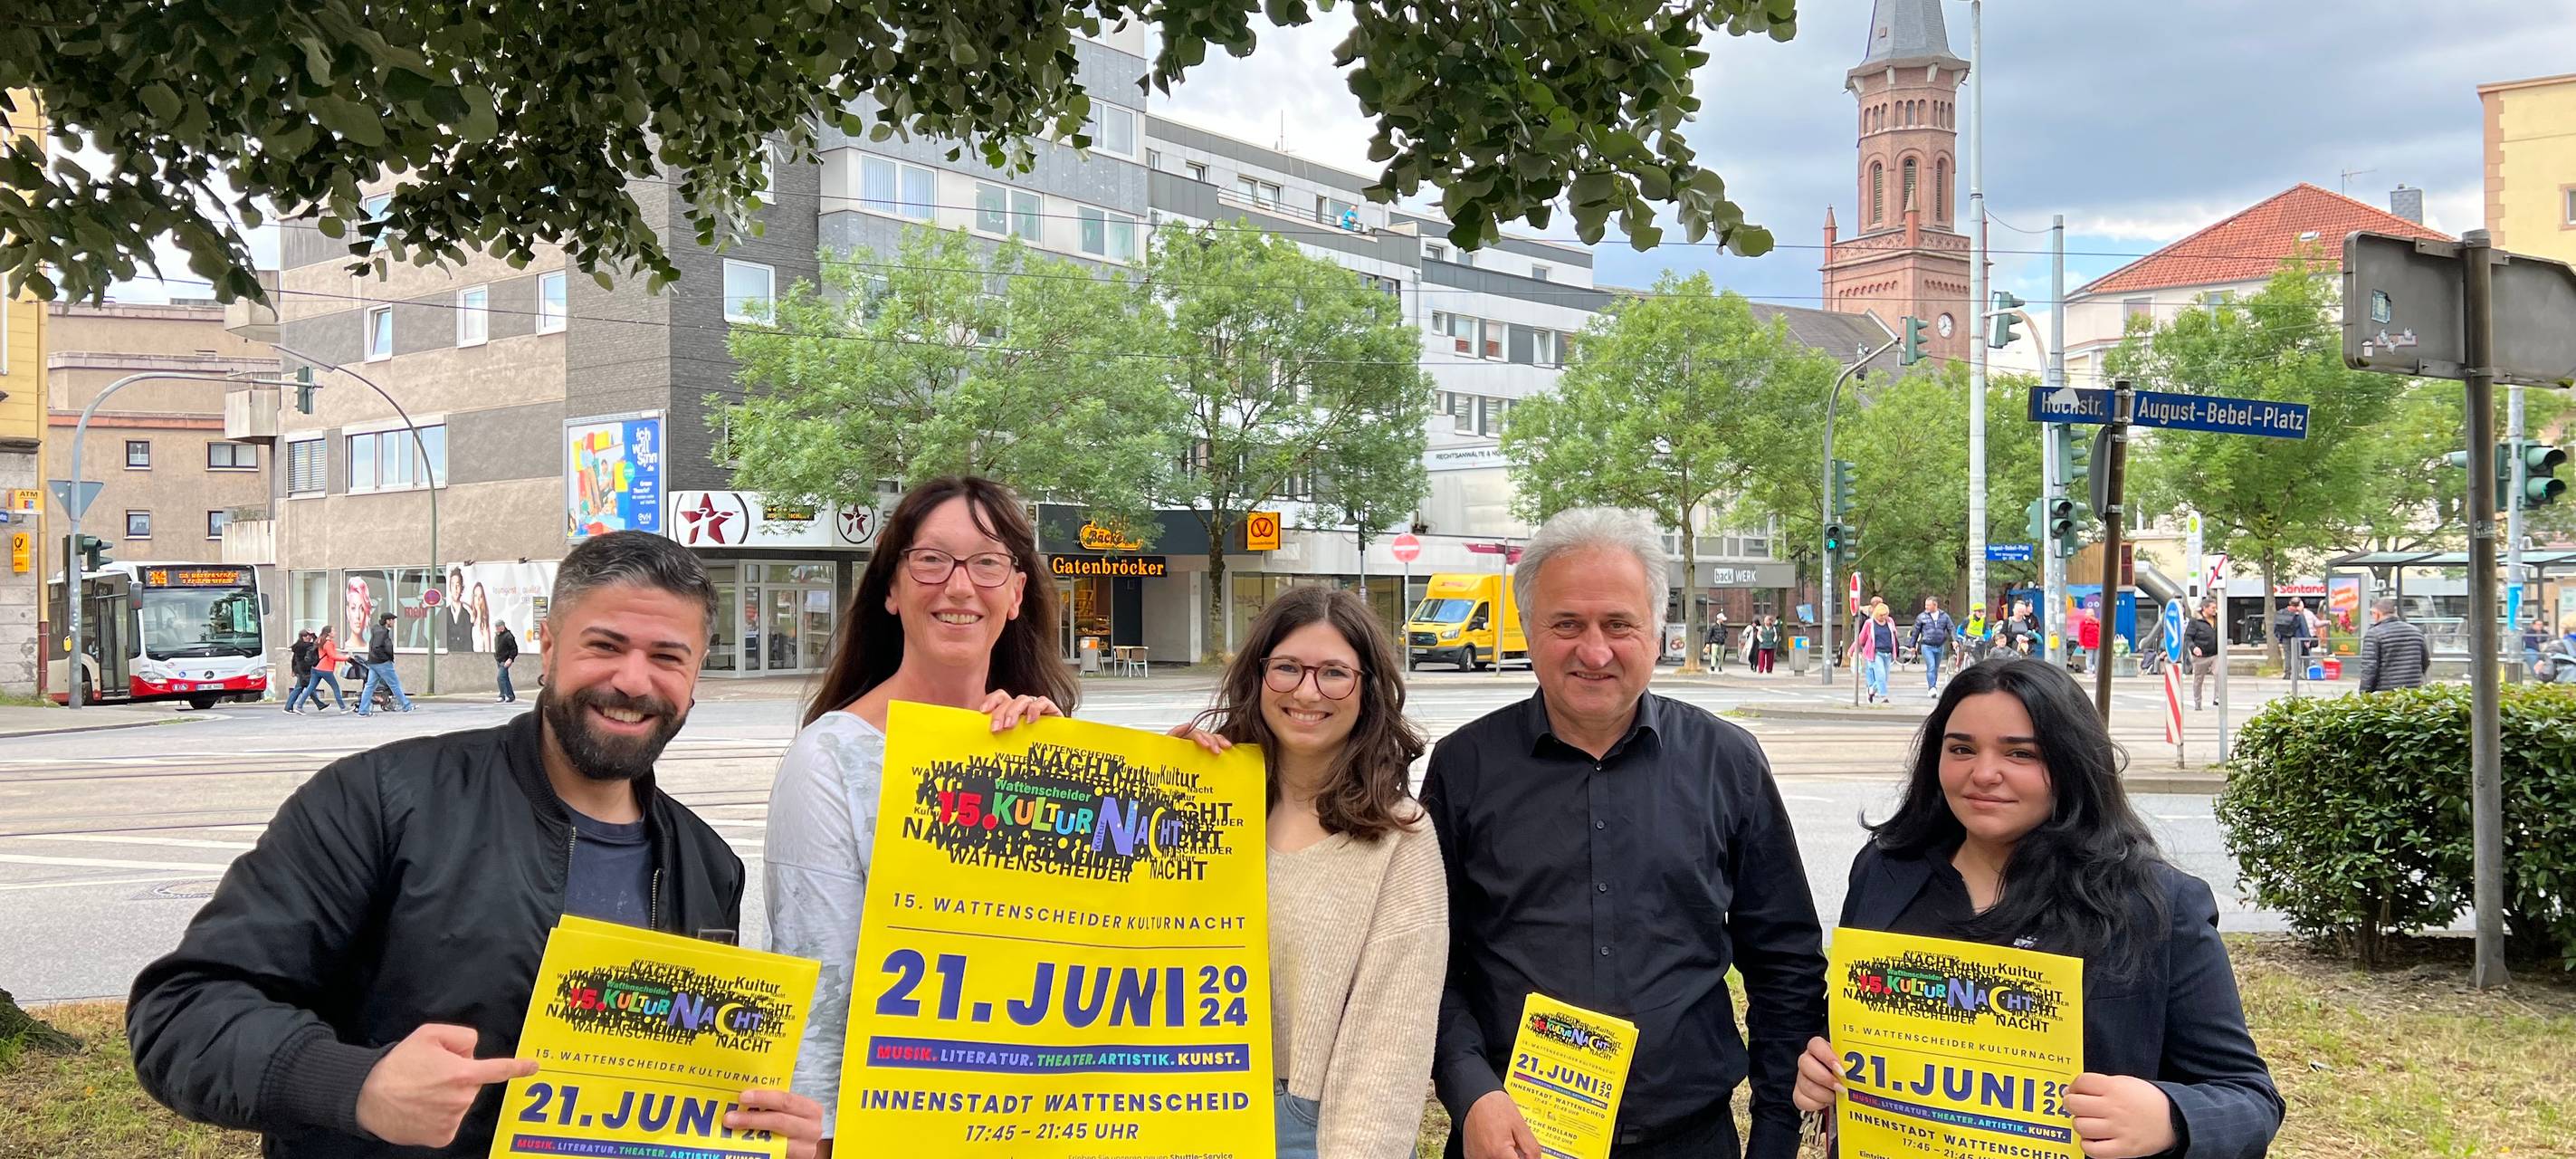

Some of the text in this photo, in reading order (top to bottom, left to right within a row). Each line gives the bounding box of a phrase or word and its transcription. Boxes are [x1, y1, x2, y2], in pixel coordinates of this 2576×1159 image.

[2137, 396, 2304, 431] August-Bebel-Platz
[1053, 557, 1164, 575] Gatenbröcker
[1714, 569, 1757, 583] back WERK
[2279, 585, 2326, 594] Santand
[995, 779, 1092, 803] Wattenscheider
[1150, 860, 1208, 880] NACHT
[893, 893, 1245, 930] 15. WATTENSCHEIDER KULTURNACHT
[1198, 965, 1247, 993] 20
[1998, 963, 2044, 981] Kultur
[734, 976, 780, 994] Kultur
[875, 949, 1184, 1028] 21. JUNI
[1199, 997, 1247, 1027] 24
[1996, 1014, 2050, 1033] NACHT
[715, 1034, 772, 1053] NACHT
[1843, 1024, 2072, 1065] 15. WATTENSCHEIDER KULTURNACHT
[536, 1049, 781, 1086] 15. WATTENSCHEIDER KULTURNACHT
[1516, 1053, 1543, 1075] 21.
[1547, 1065, 1598, 1094] JUNI
[1598, 1089, 1610, 1099] 24
[1601, 1081, 1612, 1091] 20
[1844, 1051, 2035, 1113] 21. JUNI
[519, 1082, 593, 1127] 21.
[861, 1089, 1249, 1114] INNENSTADT WATTENSCHEID
[1511, 1082, 1552, 1100] INNENSTADT
[1555, 1097, 1606, 1119] WATTENSCHEID
[966, 1125, 1016, 1142] 17:45
[1035, 1123, 1087, 1140] 21:45
[1094, 1123, 1139, 1140] UHR
[1547, 1125, 1578, 1140] HOLLAND
[1849, 1111, 2070, 1159] INNENSTADT WATTENSCHEID
[1903, 1138, 1931, 1152] 17:45
